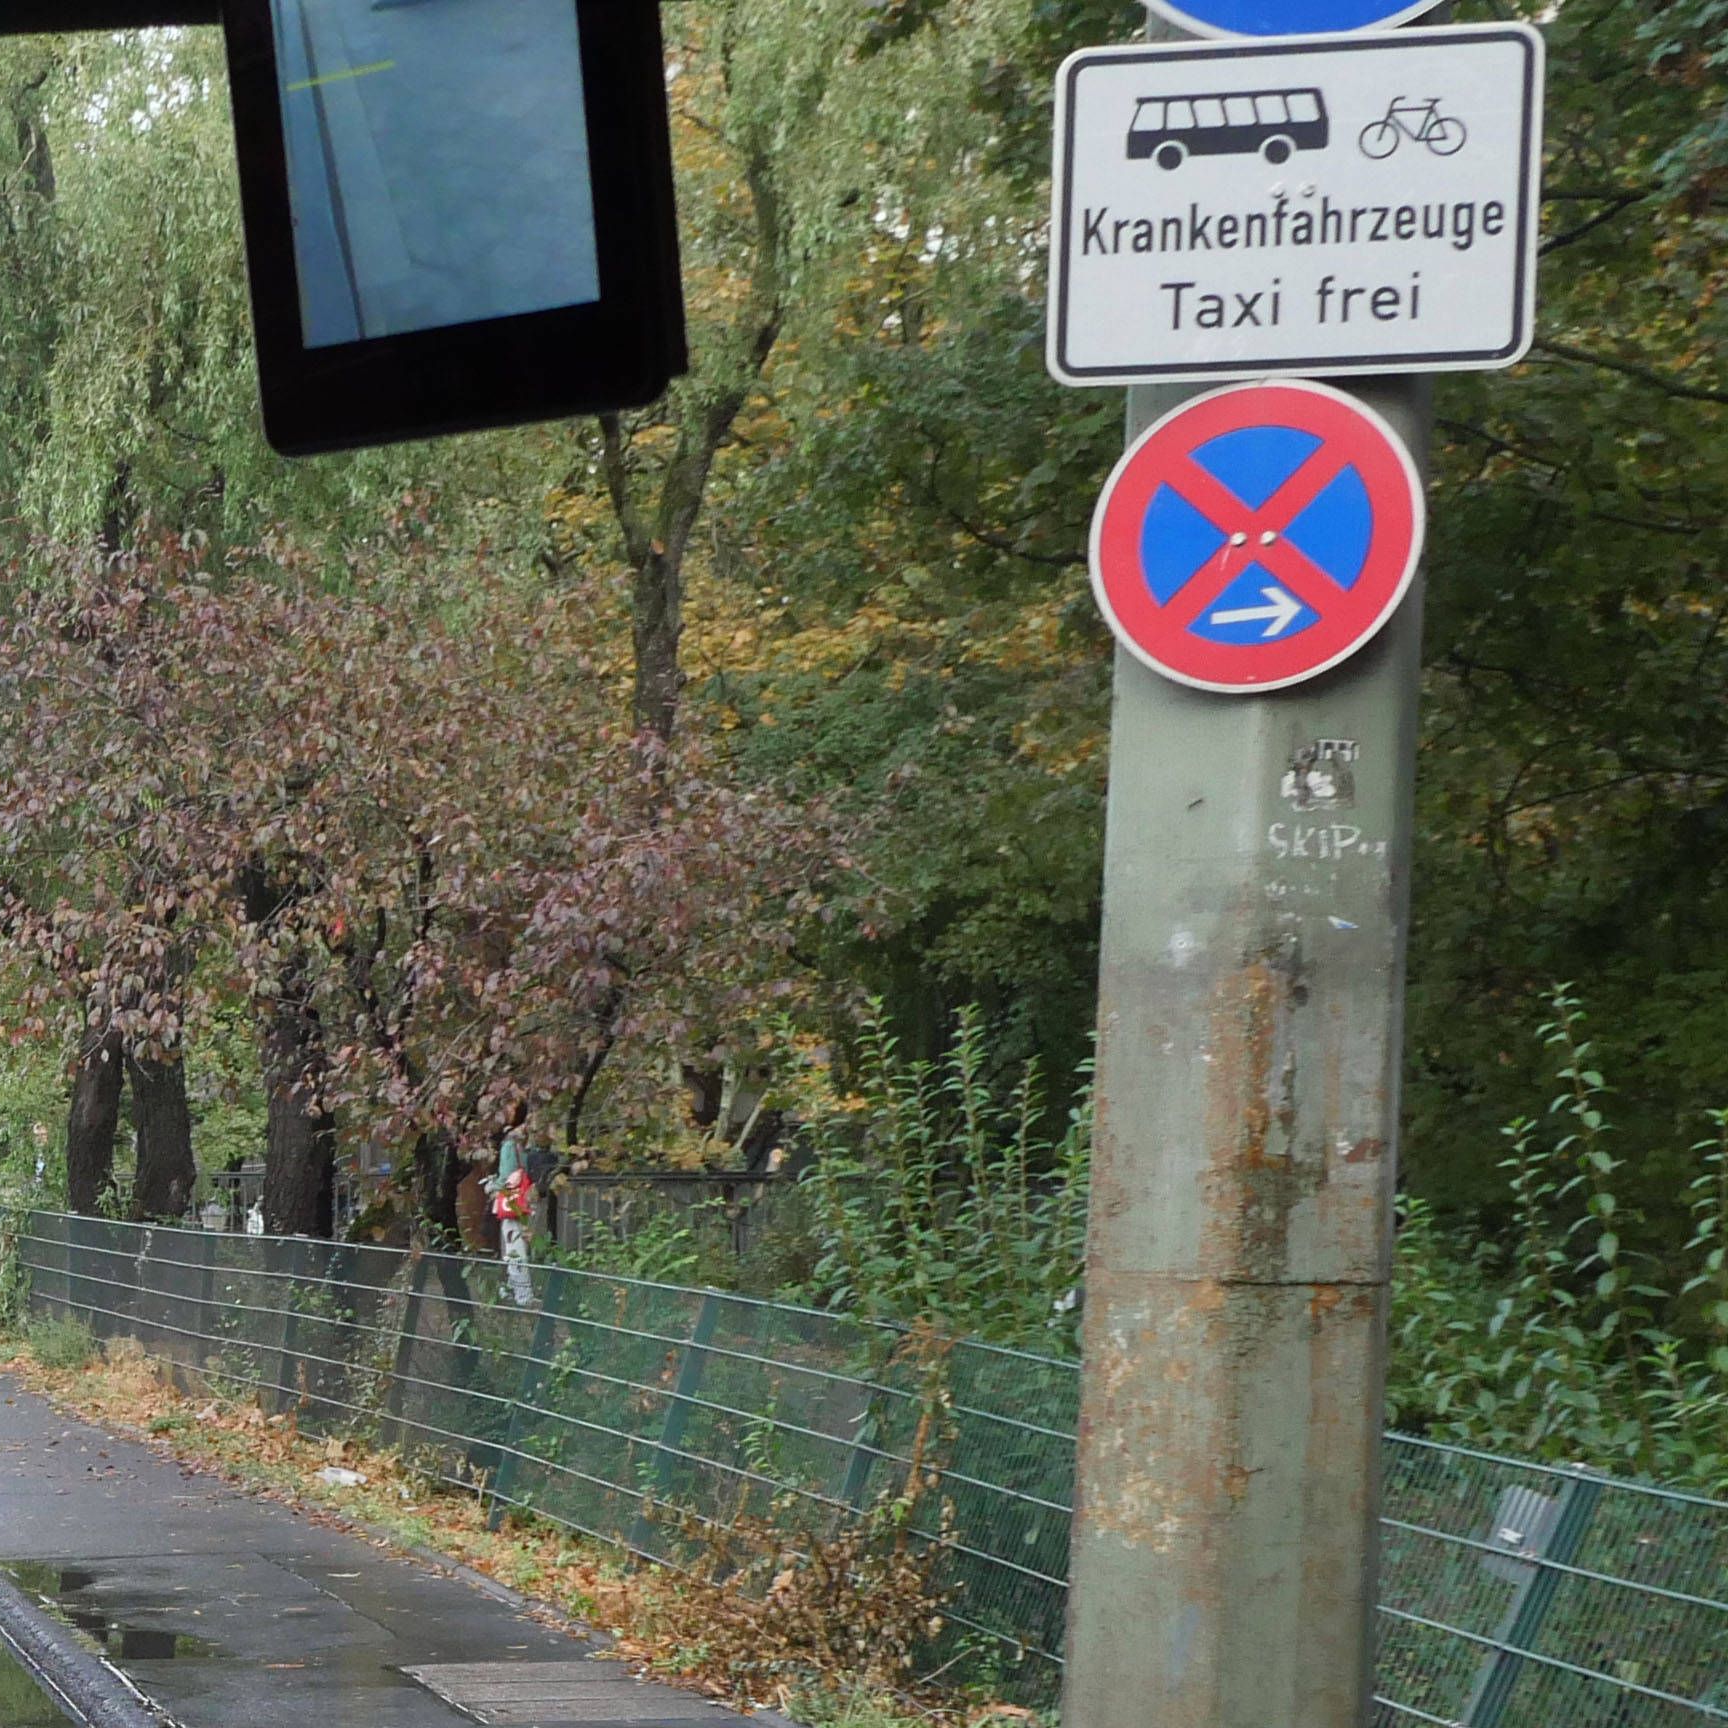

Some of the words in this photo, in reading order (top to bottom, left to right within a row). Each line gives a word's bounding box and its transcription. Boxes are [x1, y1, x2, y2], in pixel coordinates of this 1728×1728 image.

[1082, 196, 1505, 255] Krankenfahrzeuge
[1160, 279, 1282, 331] Taxi
[1316, 271, 1421, 324] frei
